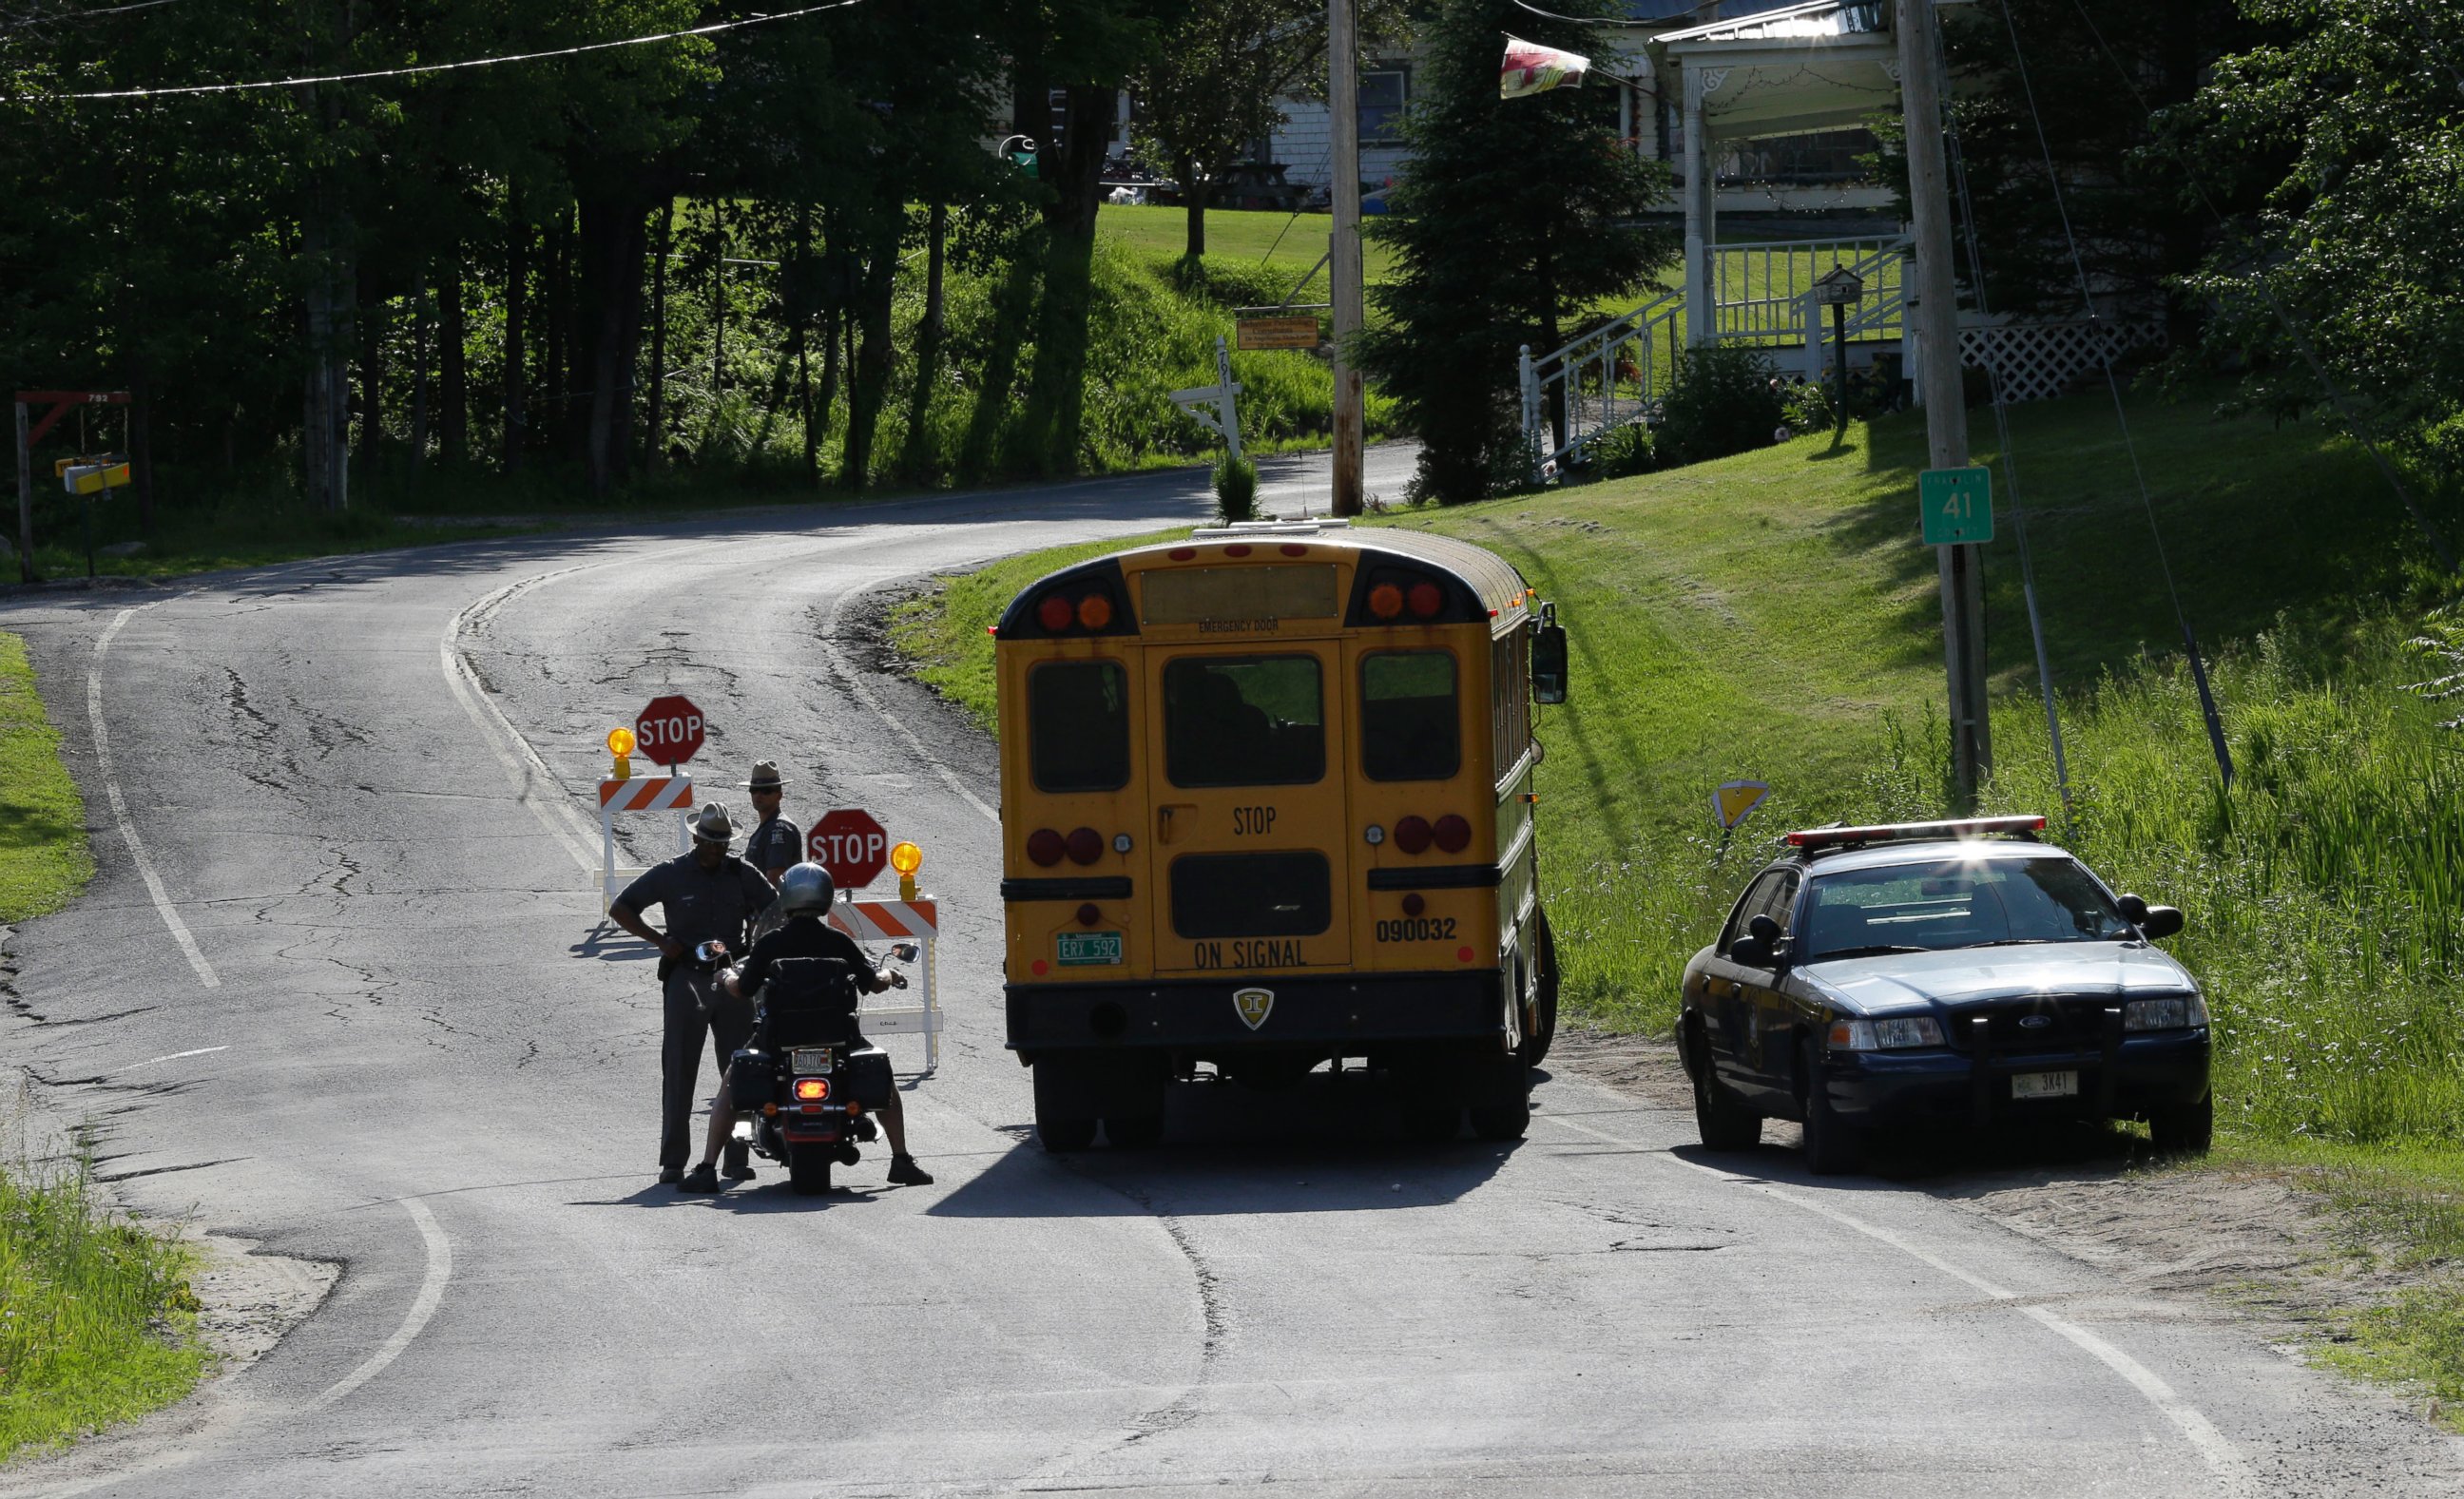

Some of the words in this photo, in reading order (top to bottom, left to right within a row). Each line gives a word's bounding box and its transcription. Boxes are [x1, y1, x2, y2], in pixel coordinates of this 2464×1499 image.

[1219, 352, 1228, 388] 791
[88, 394, 108, 402] 792
[1942, 491, 1972, 520] 41
[1199, 618, 1252, 633] EMERGENCY
[1254, 617, 1279, 631] DOOR
[639, 715, 702, 746] STOP
[1233, 805, 1277, 836] STOP
[811, 833, 884, 864] STOP
[1376, 917, 1457, 943] 090032
[1062, 940, 1085, 958] ERX
[1093, 939, 1116, 956] 592
[1194, 942, 1222, 969] ON
[1233, 939, 1307, 969] SIGNAL
[2042, 1071, 2068, 1091] 3K41
